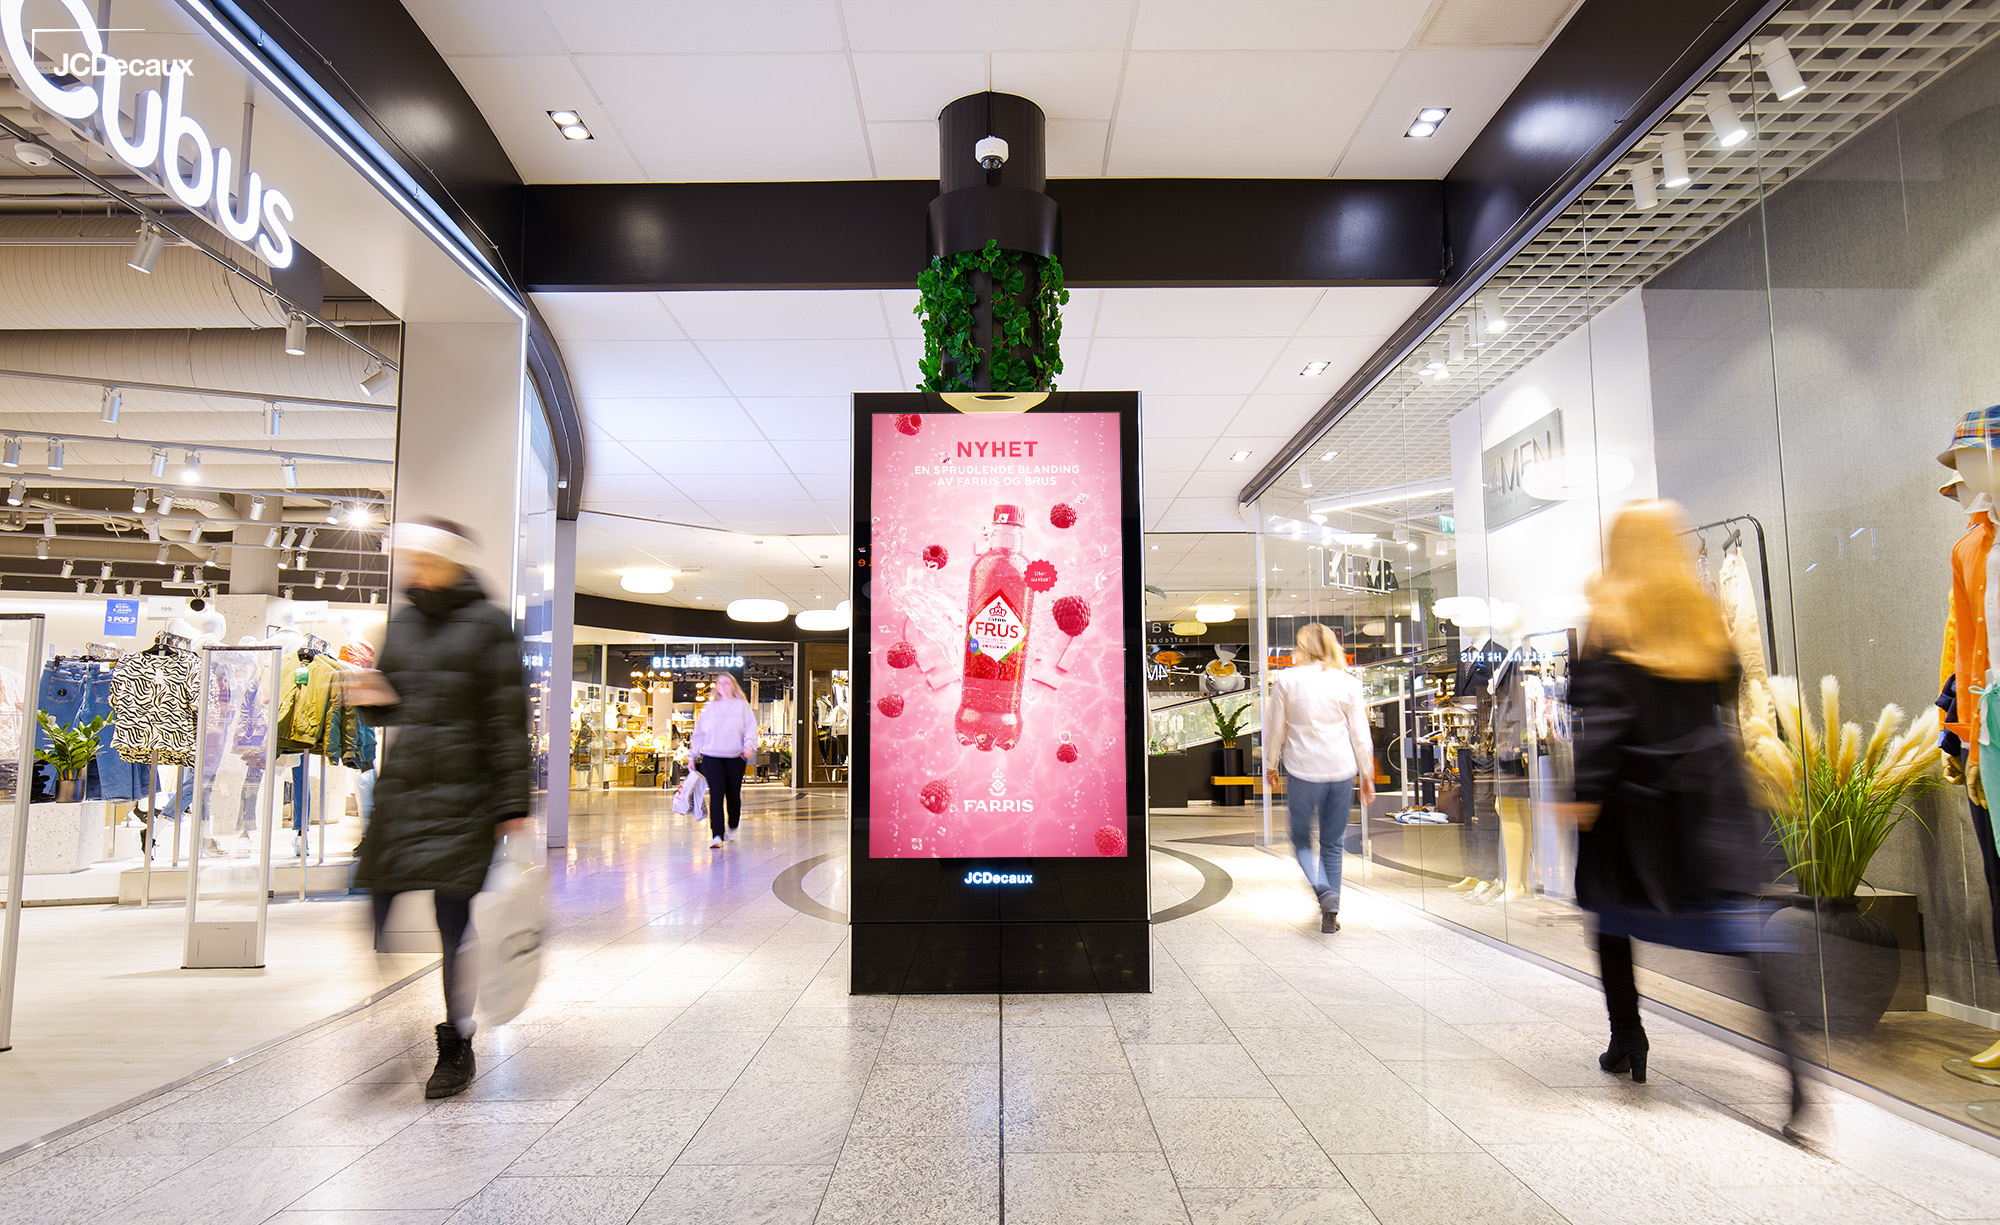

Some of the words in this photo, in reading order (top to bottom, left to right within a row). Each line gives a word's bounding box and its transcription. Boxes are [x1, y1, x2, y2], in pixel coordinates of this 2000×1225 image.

[0, 0, 295, 270] Cubus
[957, 441, 1038, 458] NYHET
[914, 466, 930, 475] EN
[933, 465, 1014, 475] SPRUDLENDE
[1015, 465, 1080, 474] BLANDING
[936, 477, 955, 486] AV
[957, 477, 999, 486] FARRIS
[1003, 477, 1021, 486] OG
[1025, 476, 1057, 486] BRUS
[975, 621, 1019, 639] FRUS
[714, 656, 744, 668] HUS
[963, 799, 1034, 813] FARRIS
[964, 871, 1033, 885] JCDecaux
